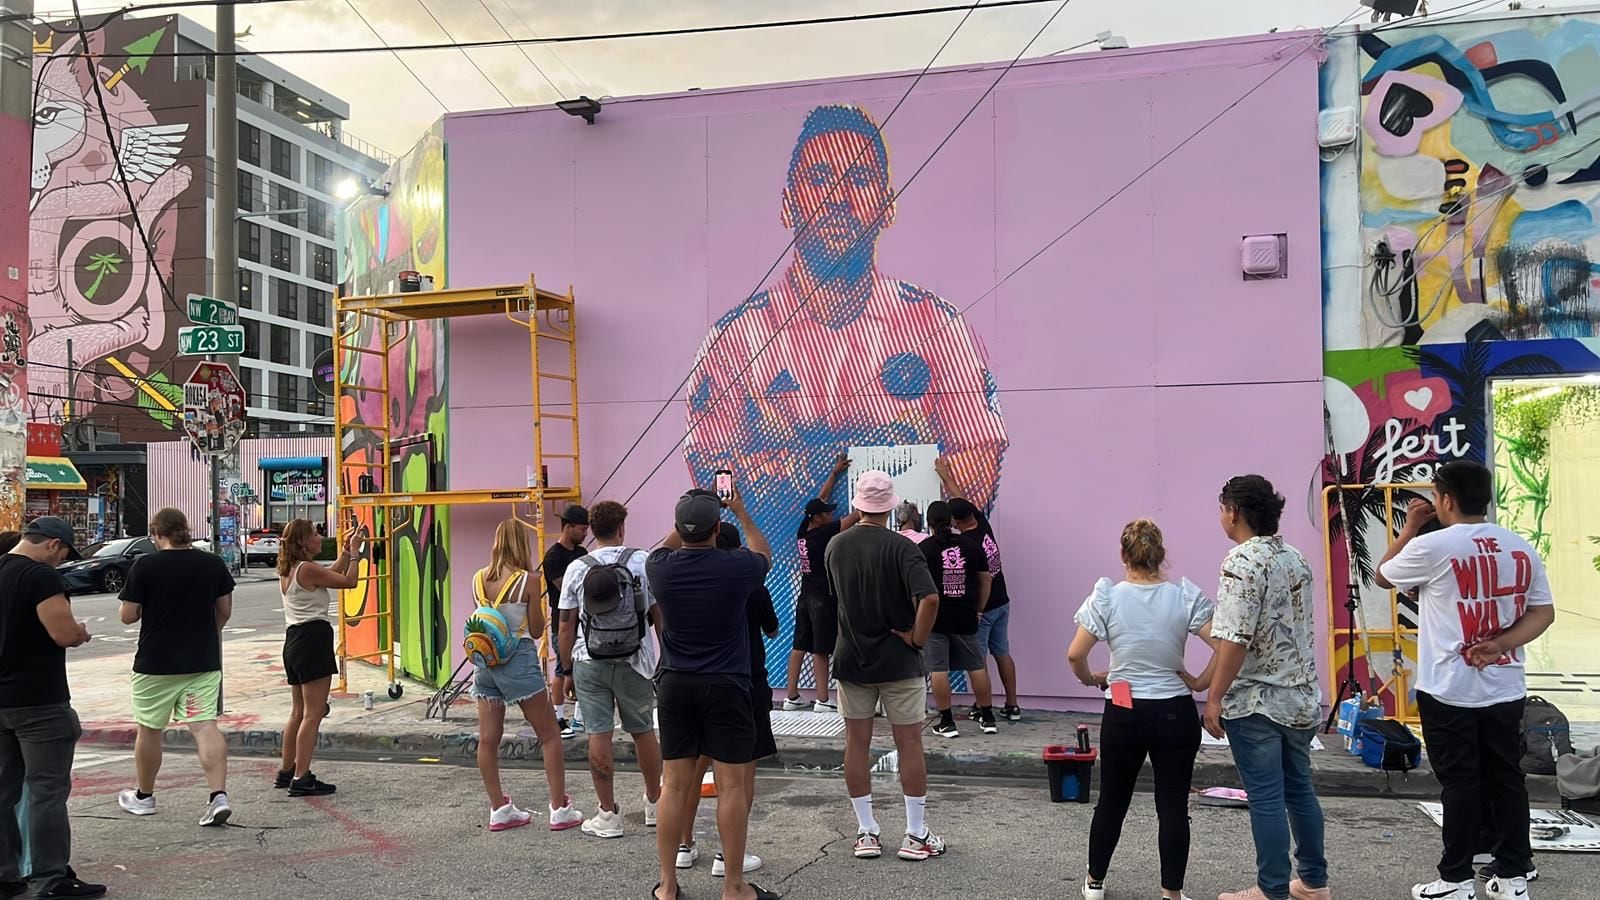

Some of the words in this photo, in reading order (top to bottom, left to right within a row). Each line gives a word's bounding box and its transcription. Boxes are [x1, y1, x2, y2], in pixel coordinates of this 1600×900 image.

[190, 302, 202, 318] NW
[209, 304, 217, 324] 2
[198, 330, 219, 351] 23
[227, 333, 240, 348] ST
[1472, 537, 1502, 554] THE
[1450, 550, 1532, 600] WILD
